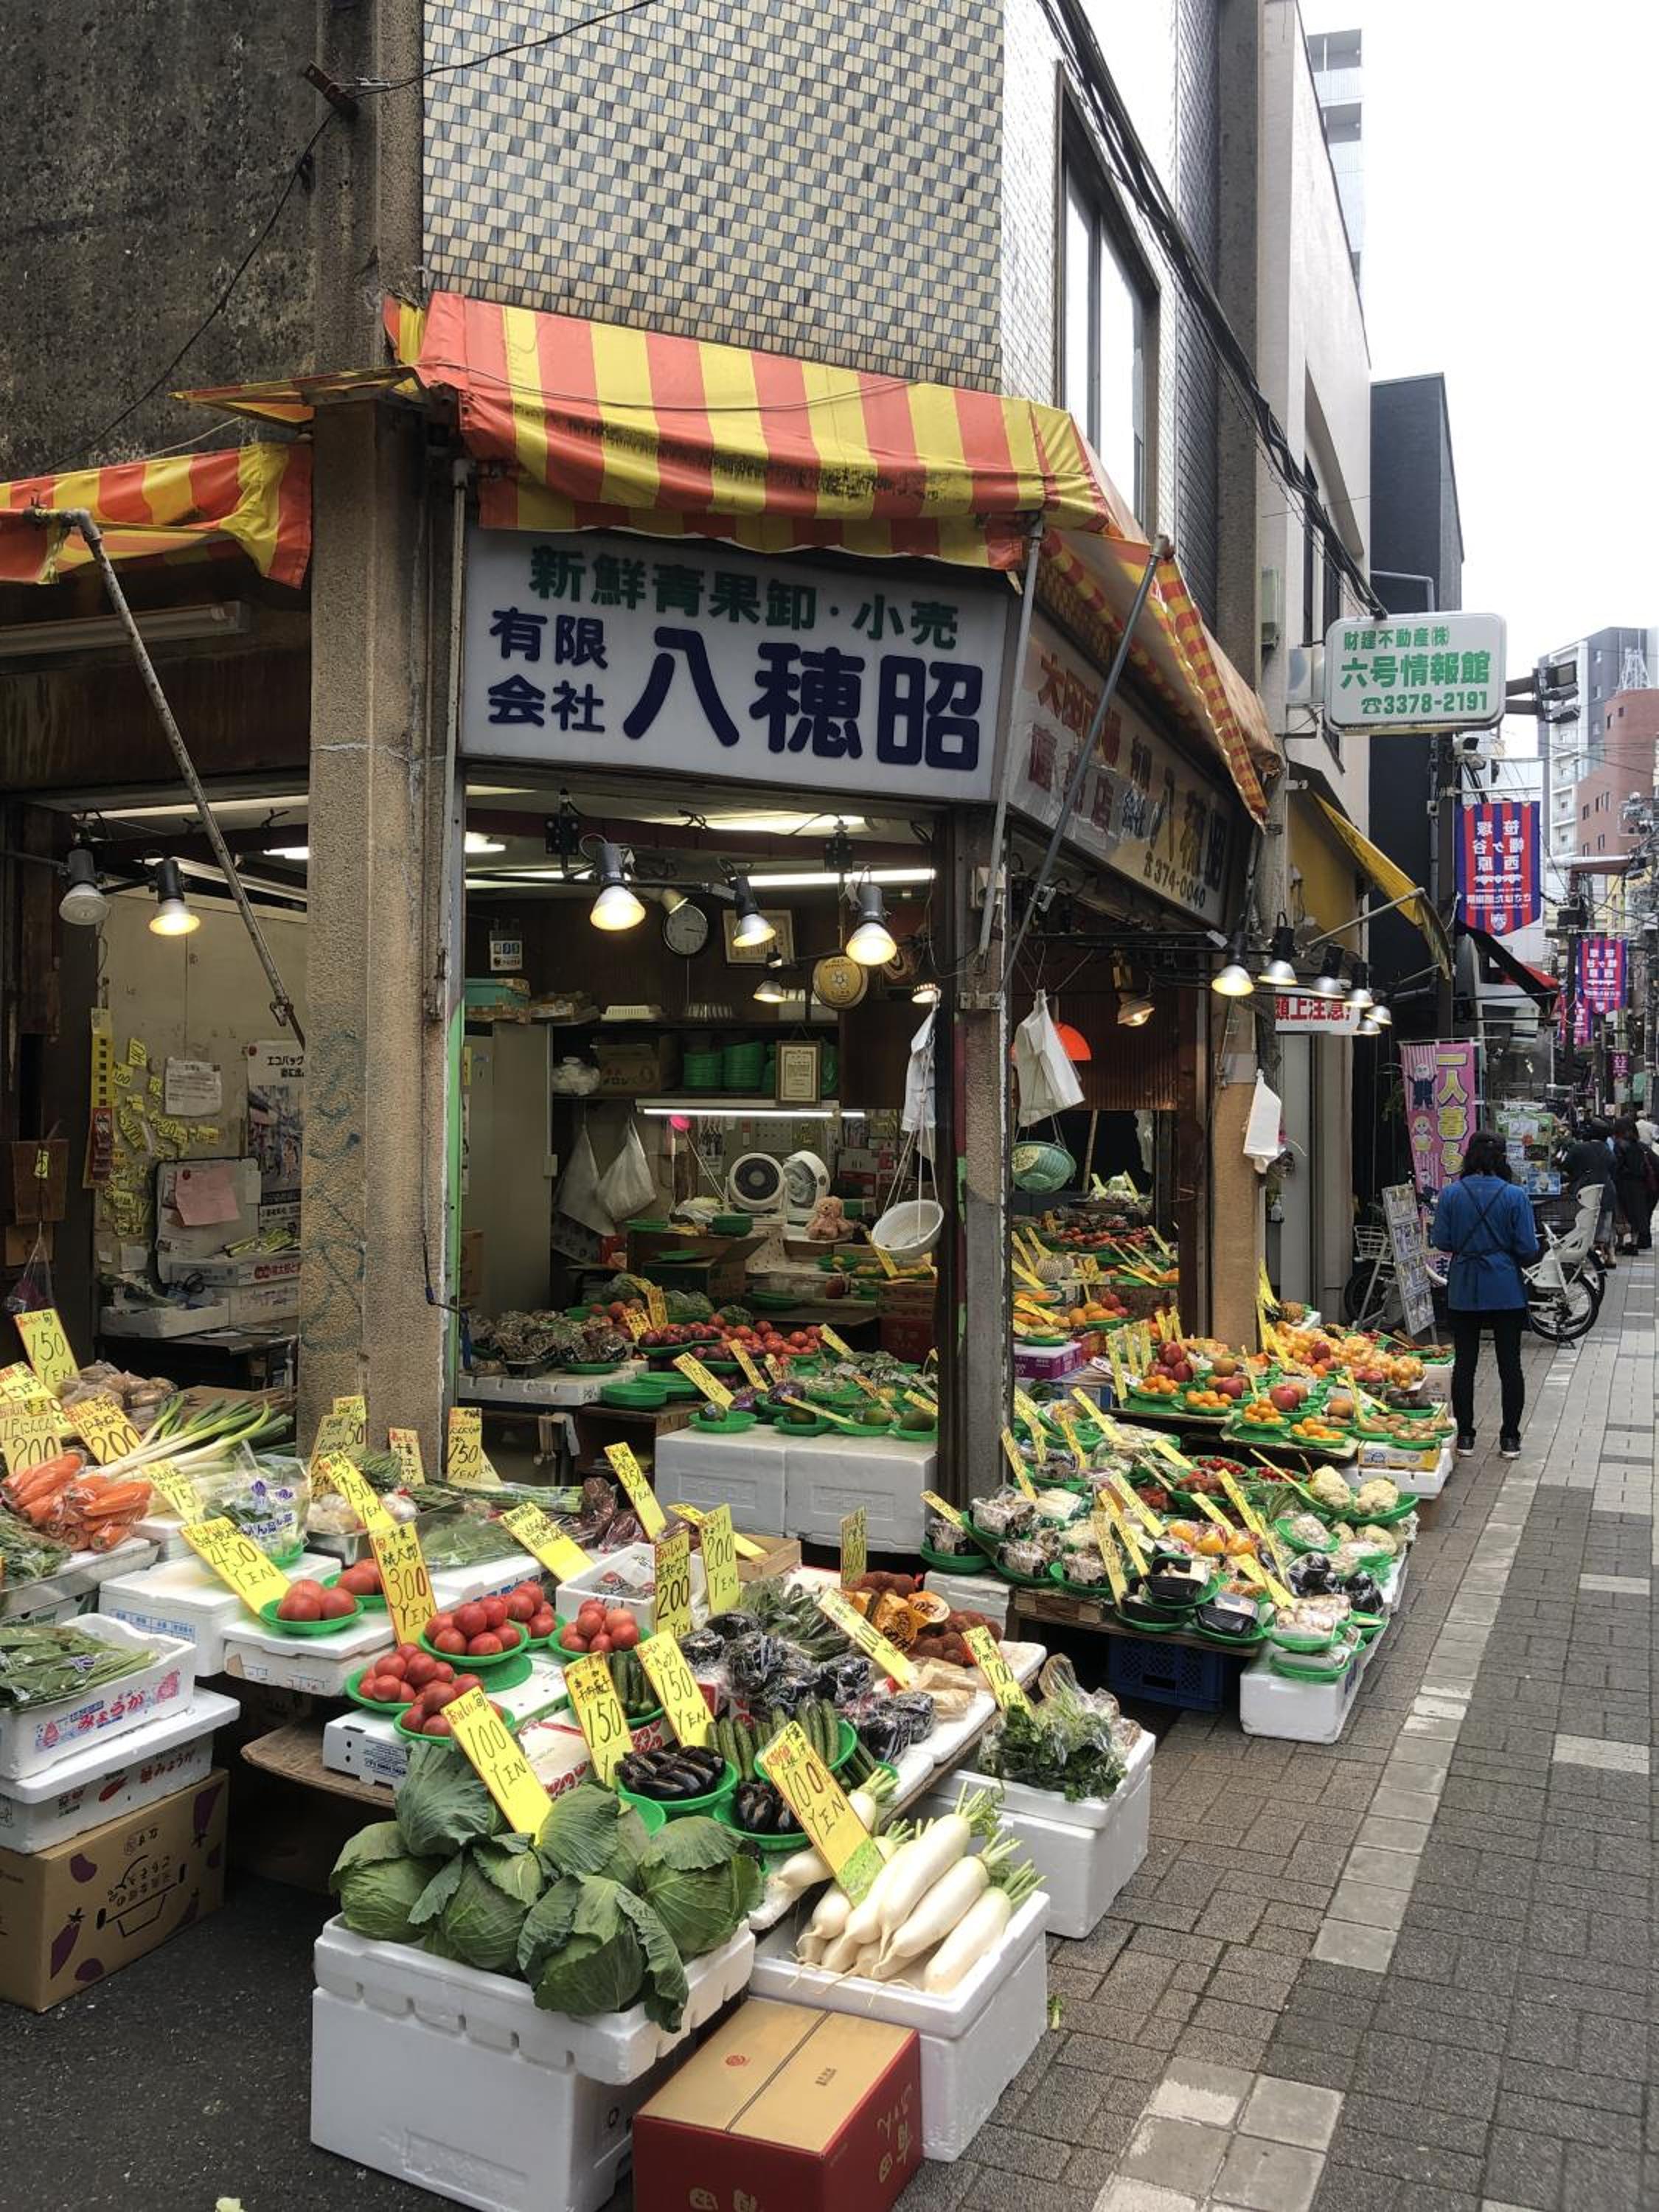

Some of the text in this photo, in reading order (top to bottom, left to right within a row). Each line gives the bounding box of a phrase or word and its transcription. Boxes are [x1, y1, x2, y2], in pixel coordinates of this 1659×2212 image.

[528, 546, 959, 650] 新鮮青果卸・小売
[490, 607, 608, 669] 有限
[1340, 651, 1491, 689] 六号情報館
[487, 674, 606, 733] 会社
[623, 626, 983, 771] 八穂昭
[1383, 691, 1488, 714] 3378-2191
[1154, 857, 1206, 909] 374-0040
[32, 1331, 66, 1362] 150
[41, 1364, 72, 1385] YEN
[12, 1436, 58, 1475] 200
[91, 1424, 142, 1466] 200
[448, 1444, 479, 1464] 150
[344, 1478, 372, 1504] 150
[449, 1467, 479, 1479] YEN
[359, 1504, 383, 1526] YEN
[210, 1541, 257, 1573] 450
[706, 1534, 734, 1572] 200
[230, 1566, 276, 1593] YEN
[389, 1566, 427, 1608] 300
[657, 1575, 690, 1619] 200
[713, 1574, 736, 1599] YEN
[398, 1604, 433, 1632] YEN
[671, 1618, 692, 1638] YEN
[661, 1667, 693, 1705] 150
[986, 1661, 1015, 1686] 100
[77, 1693, 146, 1731] みょうが
[588, 1698, 623, 1748] 150
[674, 1706, 708, 1735] YEN
[467, 1719, 507, 1767] 100
[490, 1758, 528, 1800] YEN
[785, 1761, 825, 1815] 100
[807, 1792, 846, 1846] YEN
